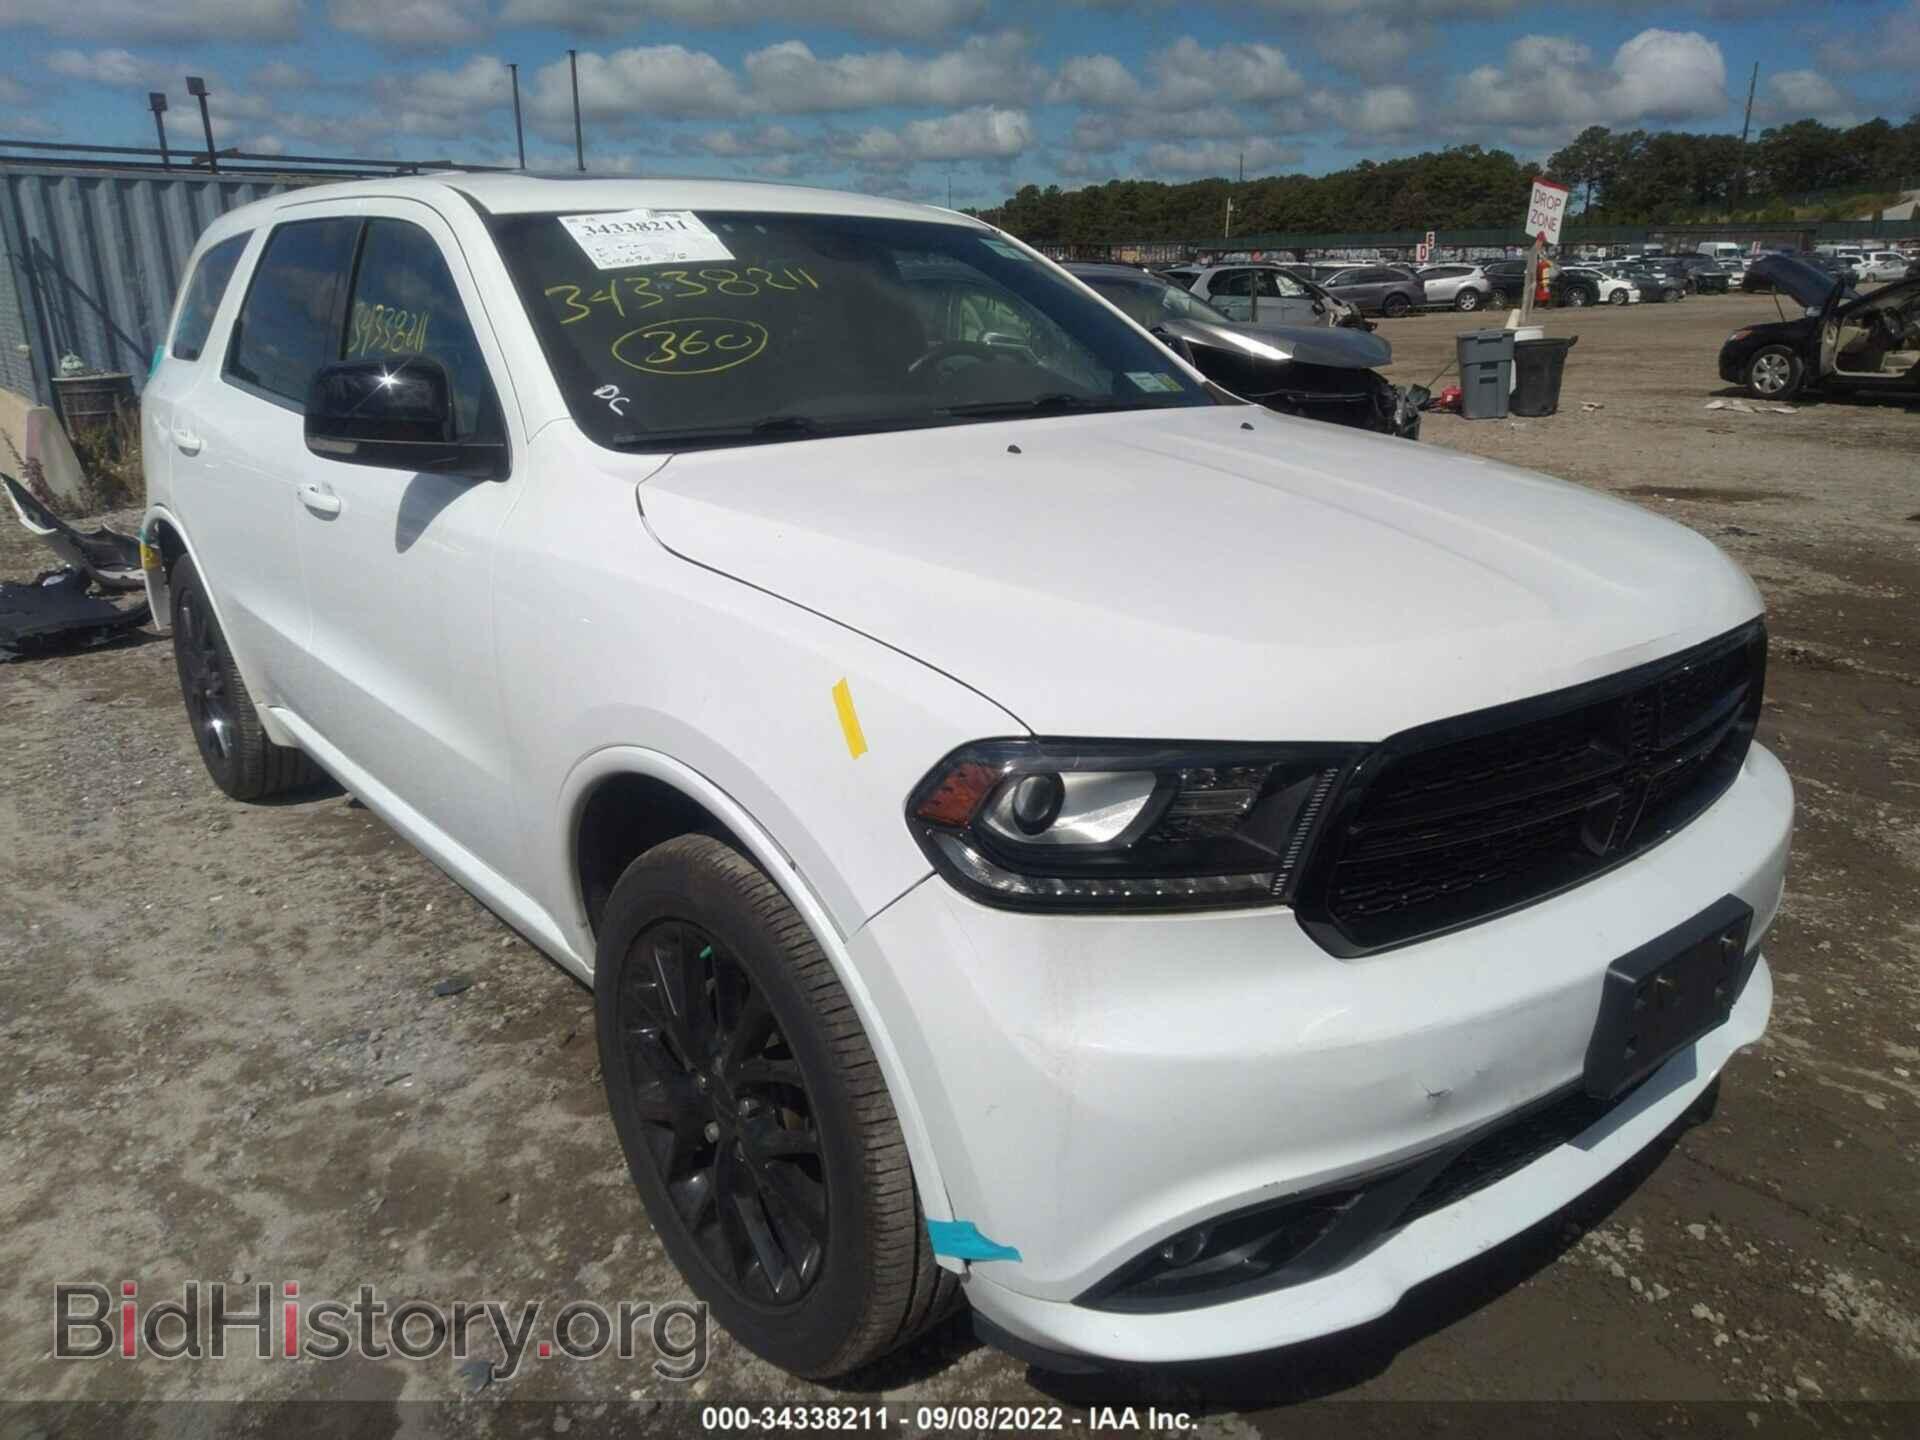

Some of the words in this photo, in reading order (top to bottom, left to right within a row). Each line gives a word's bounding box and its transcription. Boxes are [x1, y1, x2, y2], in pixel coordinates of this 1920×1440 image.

[1534, 189, 1561, 210] DROP
[582, 220, 689, 236] 34338211
[1530, 208, 1557, 232] ZONE
[545, 267, 819, 324] 34338211
